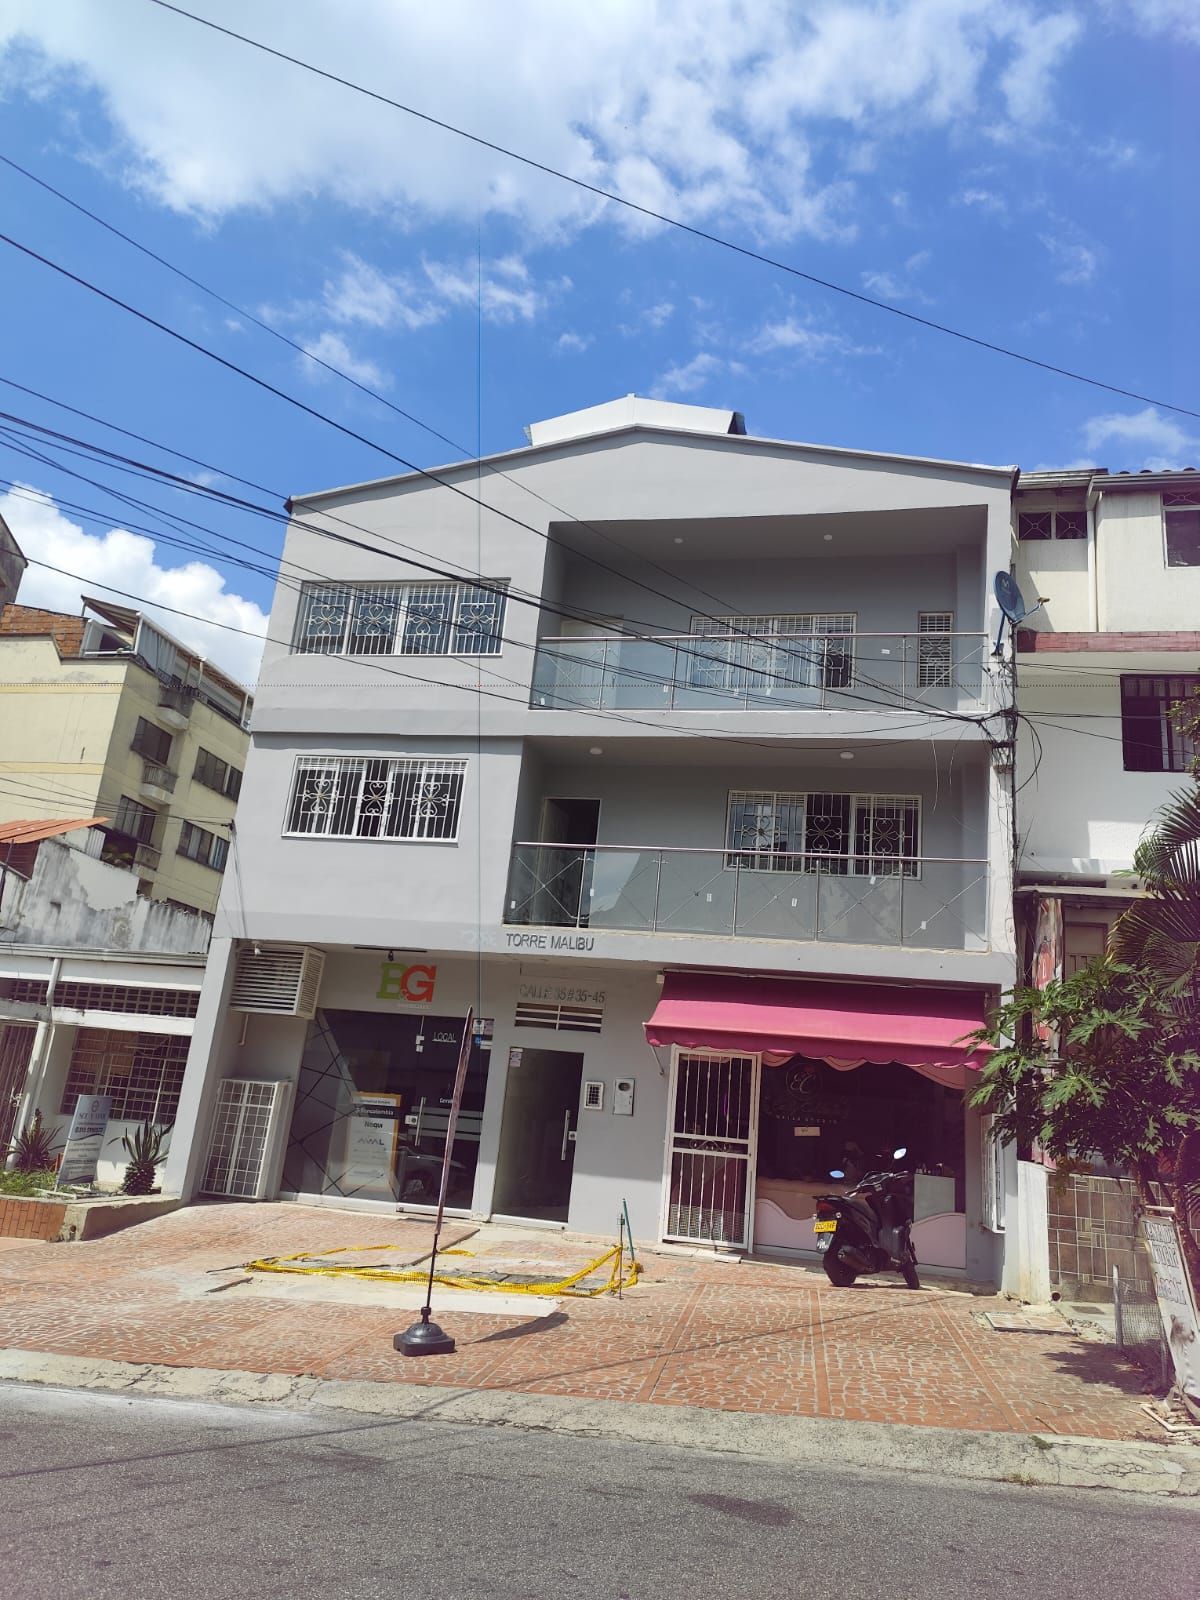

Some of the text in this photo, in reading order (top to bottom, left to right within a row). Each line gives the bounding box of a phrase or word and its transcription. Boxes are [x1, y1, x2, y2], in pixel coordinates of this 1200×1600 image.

[506, 933, 547, 949] TORRE
[550, 935, 594, 951] MALIBU
[520, 984, 552, 1000] CALLE
[433, 1031, 456, 1041] LOCAL
